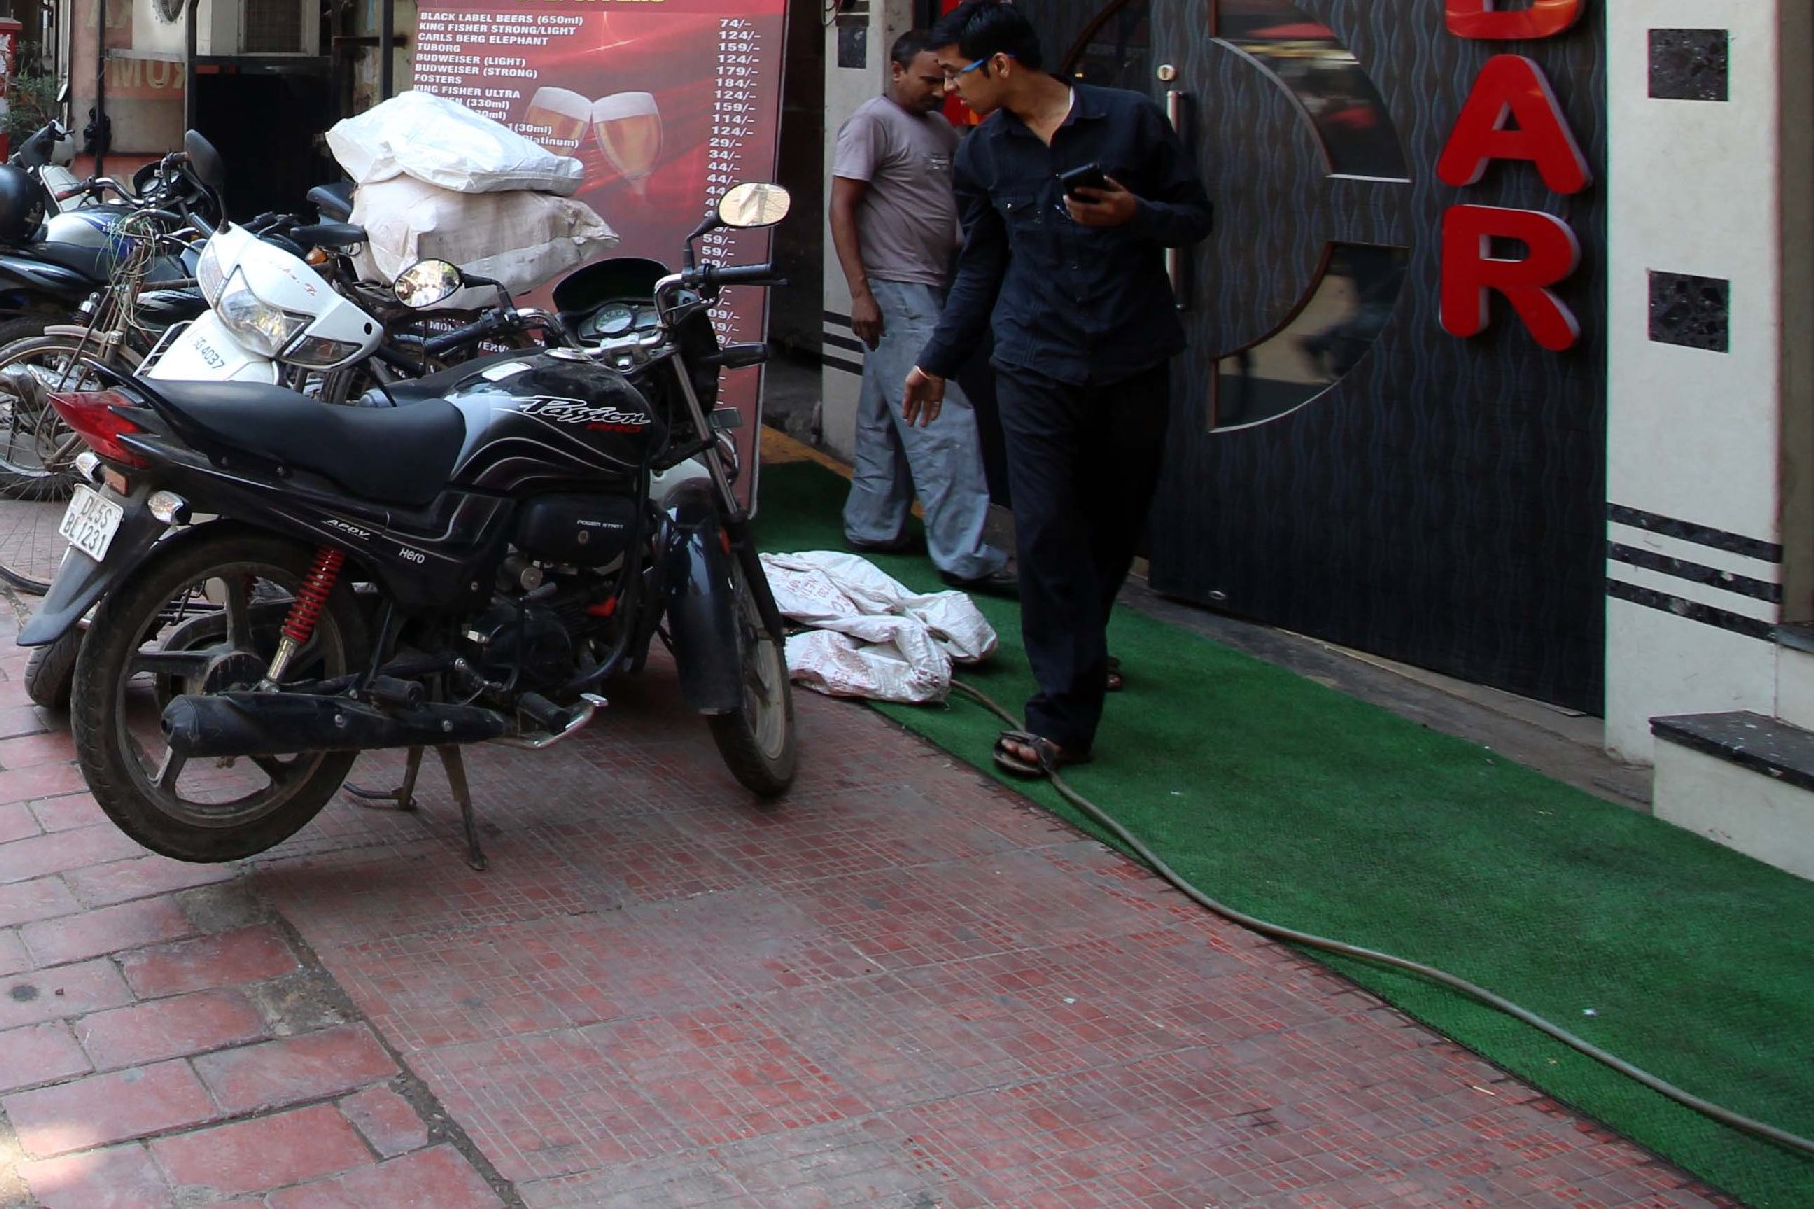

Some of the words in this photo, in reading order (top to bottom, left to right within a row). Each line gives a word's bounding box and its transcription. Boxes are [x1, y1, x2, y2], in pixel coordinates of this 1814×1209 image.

[420, 12, 456, 22] BLACK
[458, 13, 493, 23] LABEL
[496, 14, 533, 23] BEERS
[537, 15, 583, 26] (650ml)
[719, 19, 752, 28] 74/-
[419, 22, 445, 32] KING
[448, 23, 488, 33] FISHER
[491, 25, 576, 35] STRONG/LIGHT
[718, 31, 761, 40] 124/-
[418, 33, 453, 43] CARLS
[456, 34, 486, 44] BERG
[489, 35, 549, 46] ELEPHANT
[718, 42, 760, 52] 159/-
[417, 43, 461, 53] TUBORG
[717, 54, 760, 64] 124/-
[416, 53, 480, 65] BUDWEISER
[484, 57, 526, 67] (LIGHT)
[716, 66, 758, 76] 179/-
[415, 64, 479, 75] BUDWEISER
[483, 68, 538, 79] (STRONG)
[715, 78, 757, 88] 184/-
[414, 74, 462, 84] FOSTERS
[714, 90, 756, 100] 124/-
[413, 84, 438, 93] KING
[441, 86, 482, 97] FISHER
[485, 89, 521, 99] ULTRA
[713, 102, 756, 112] 159/-
[466, 99, 510, 110] (330ml)
[712, 114, 755, 124] 114/-
[711, 126, 754, 136] 124/-
[709, 138, 743, 149] 29/-
[709, 150, 742, 160] 34/-
[708, 162, 741, 172] 44/-
[706, 174, 740, 184] 44/-
[702, 234, 736, 245] 59/-
[701, 246, 735, 257] 59/-
[398, 547, 426, 564] Hero
